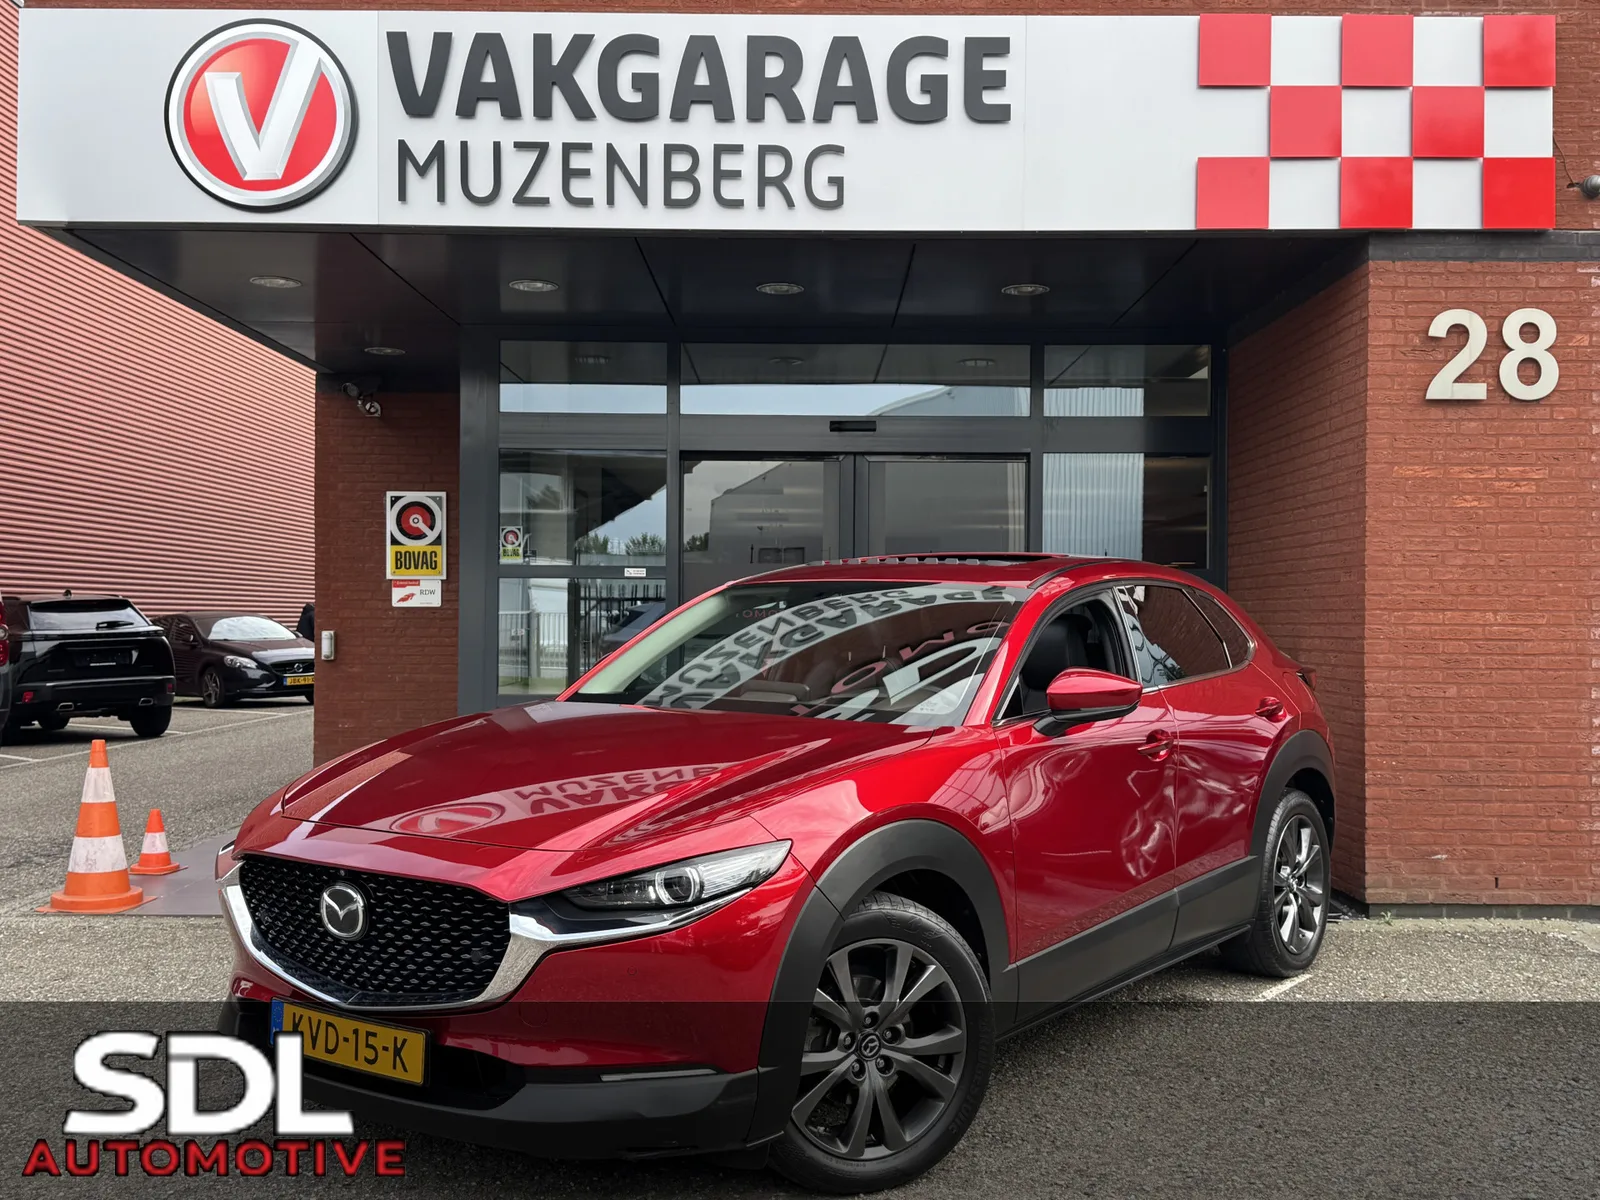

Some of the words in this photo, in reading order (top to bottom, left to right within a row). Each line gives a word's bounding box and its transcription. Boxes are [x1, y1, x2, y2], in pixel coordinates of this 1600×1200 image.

[204, 40, 323, 181] V
[386, 31, 1011, 124] VAKGARAGE
[398, 139, 846, 210] MUZENBERG
[1425, 308, 1559, 402] 28
[394, 549, 438, 571] BOVAG
[419, 588, 436, 596] RDW
